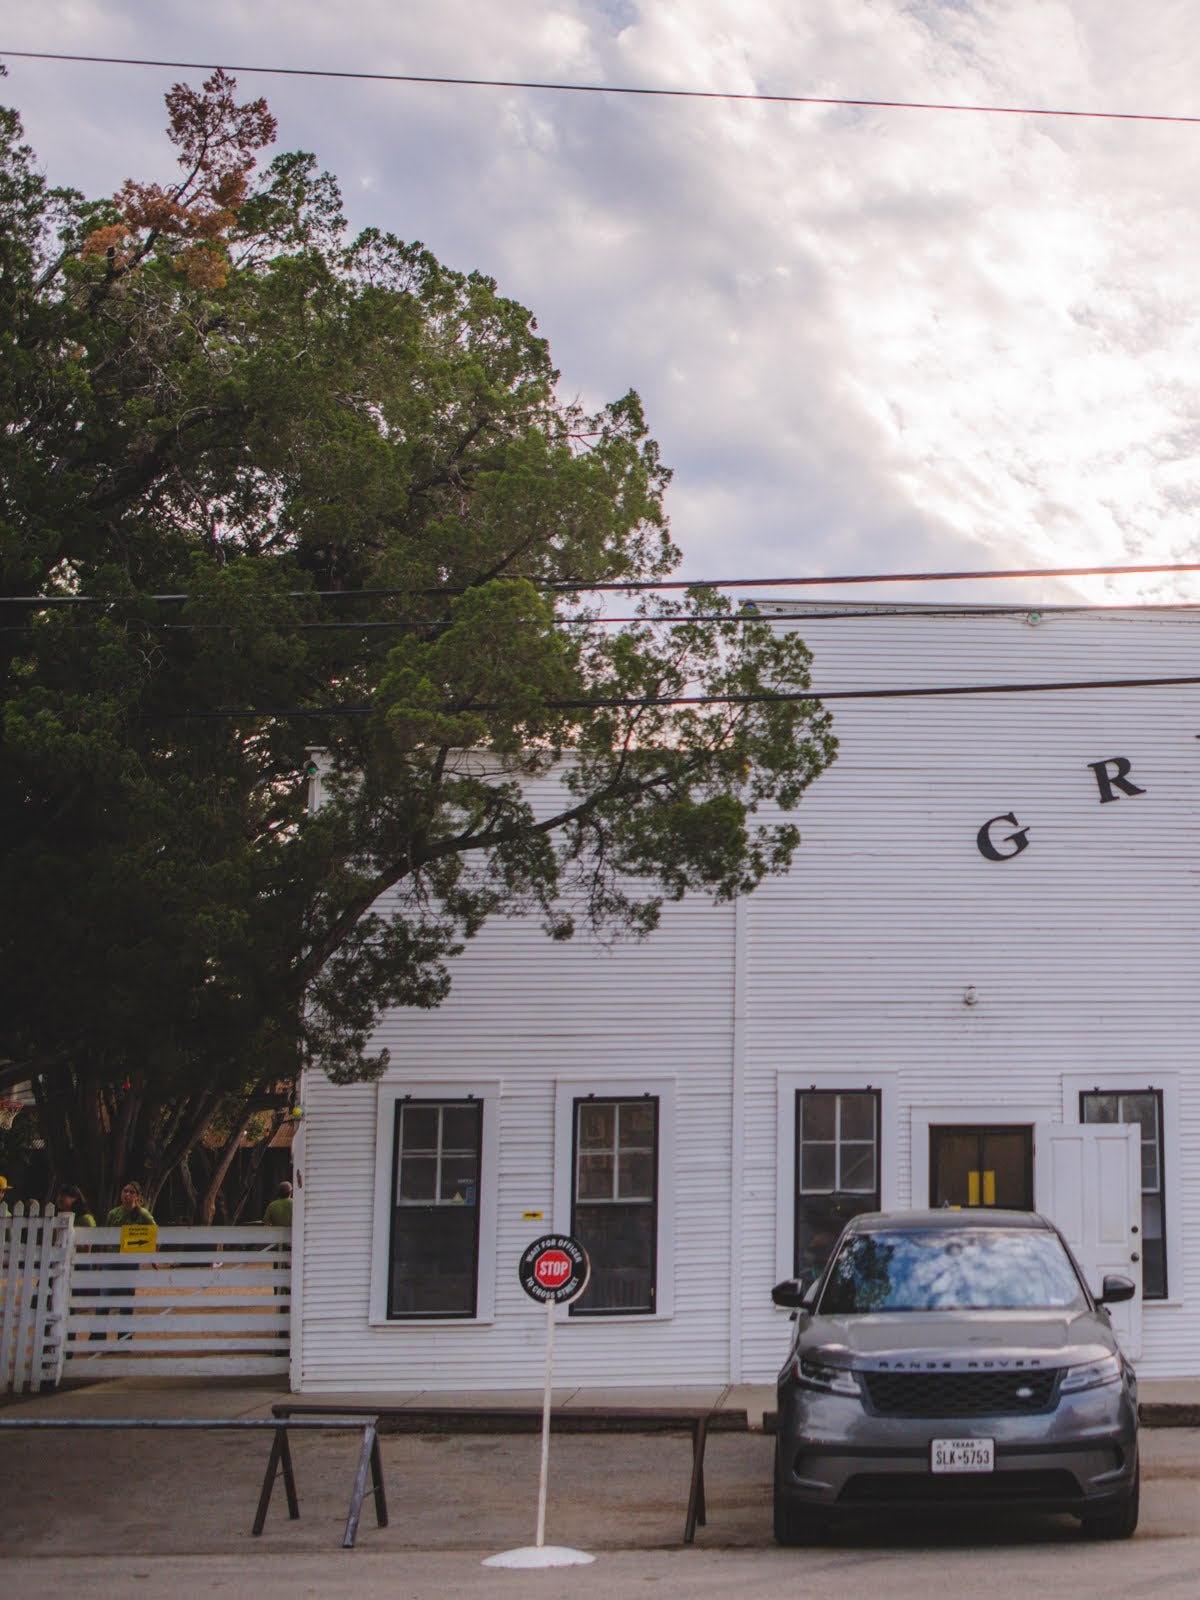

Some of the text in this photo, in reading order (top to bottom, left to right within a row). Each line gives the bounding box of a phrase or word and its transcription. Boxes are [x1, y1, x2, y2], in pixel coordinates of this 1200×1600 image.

[525, 1238, 583, 1263] WAIT FOR OFFICER
[539, 1260, 569, 1276] STOP
[526, 1276, 580, 1299] TO CROSS STREET
[878, 1360, 1041, 1369] RANGE ROVER
